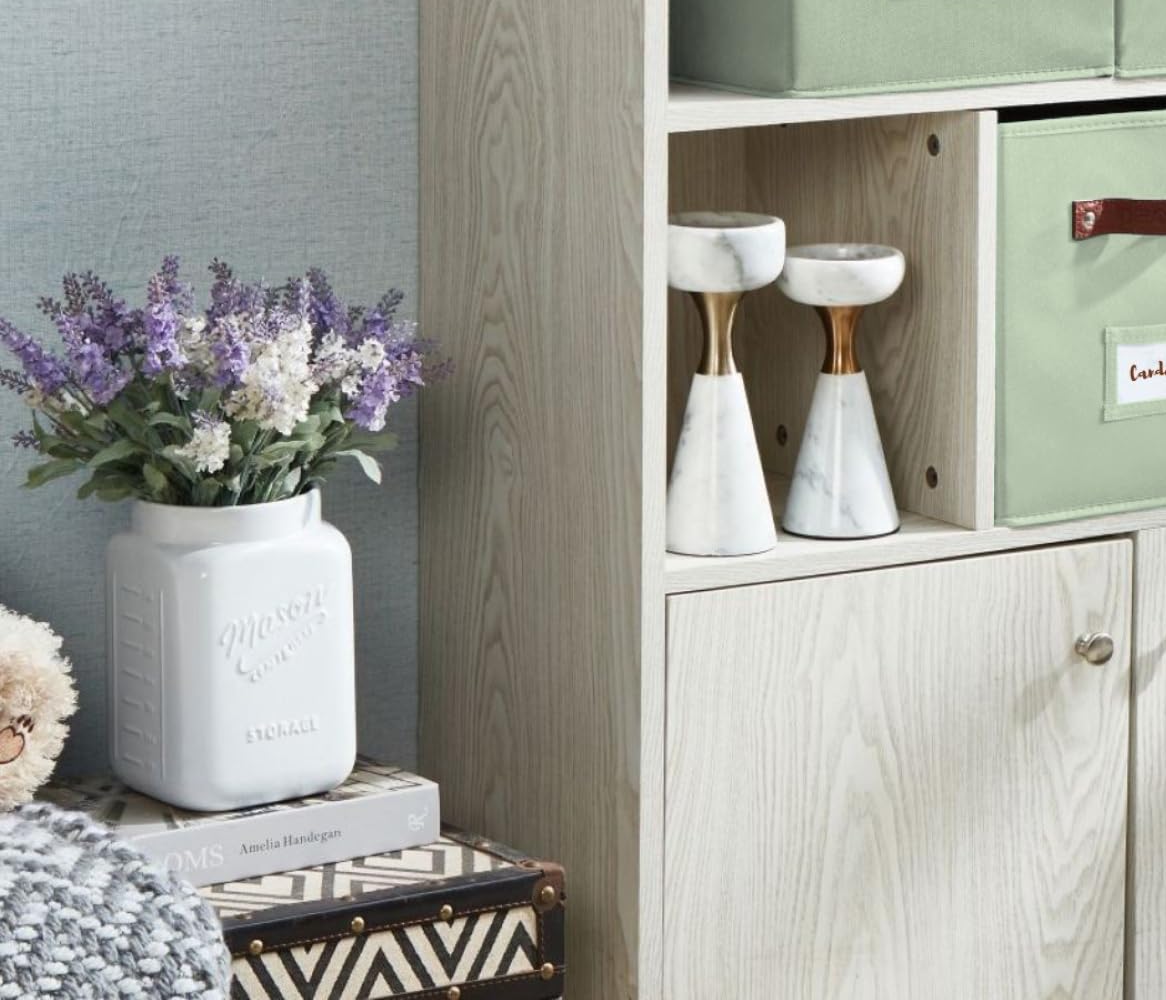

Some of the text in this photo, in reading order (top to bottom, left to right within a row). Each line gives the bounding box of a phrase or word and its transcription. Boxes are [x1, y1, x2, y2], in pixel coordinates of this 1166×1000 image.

[218, 584, 327, 660] Mason
[240, 828, 342, 856] Amelia Handegan
